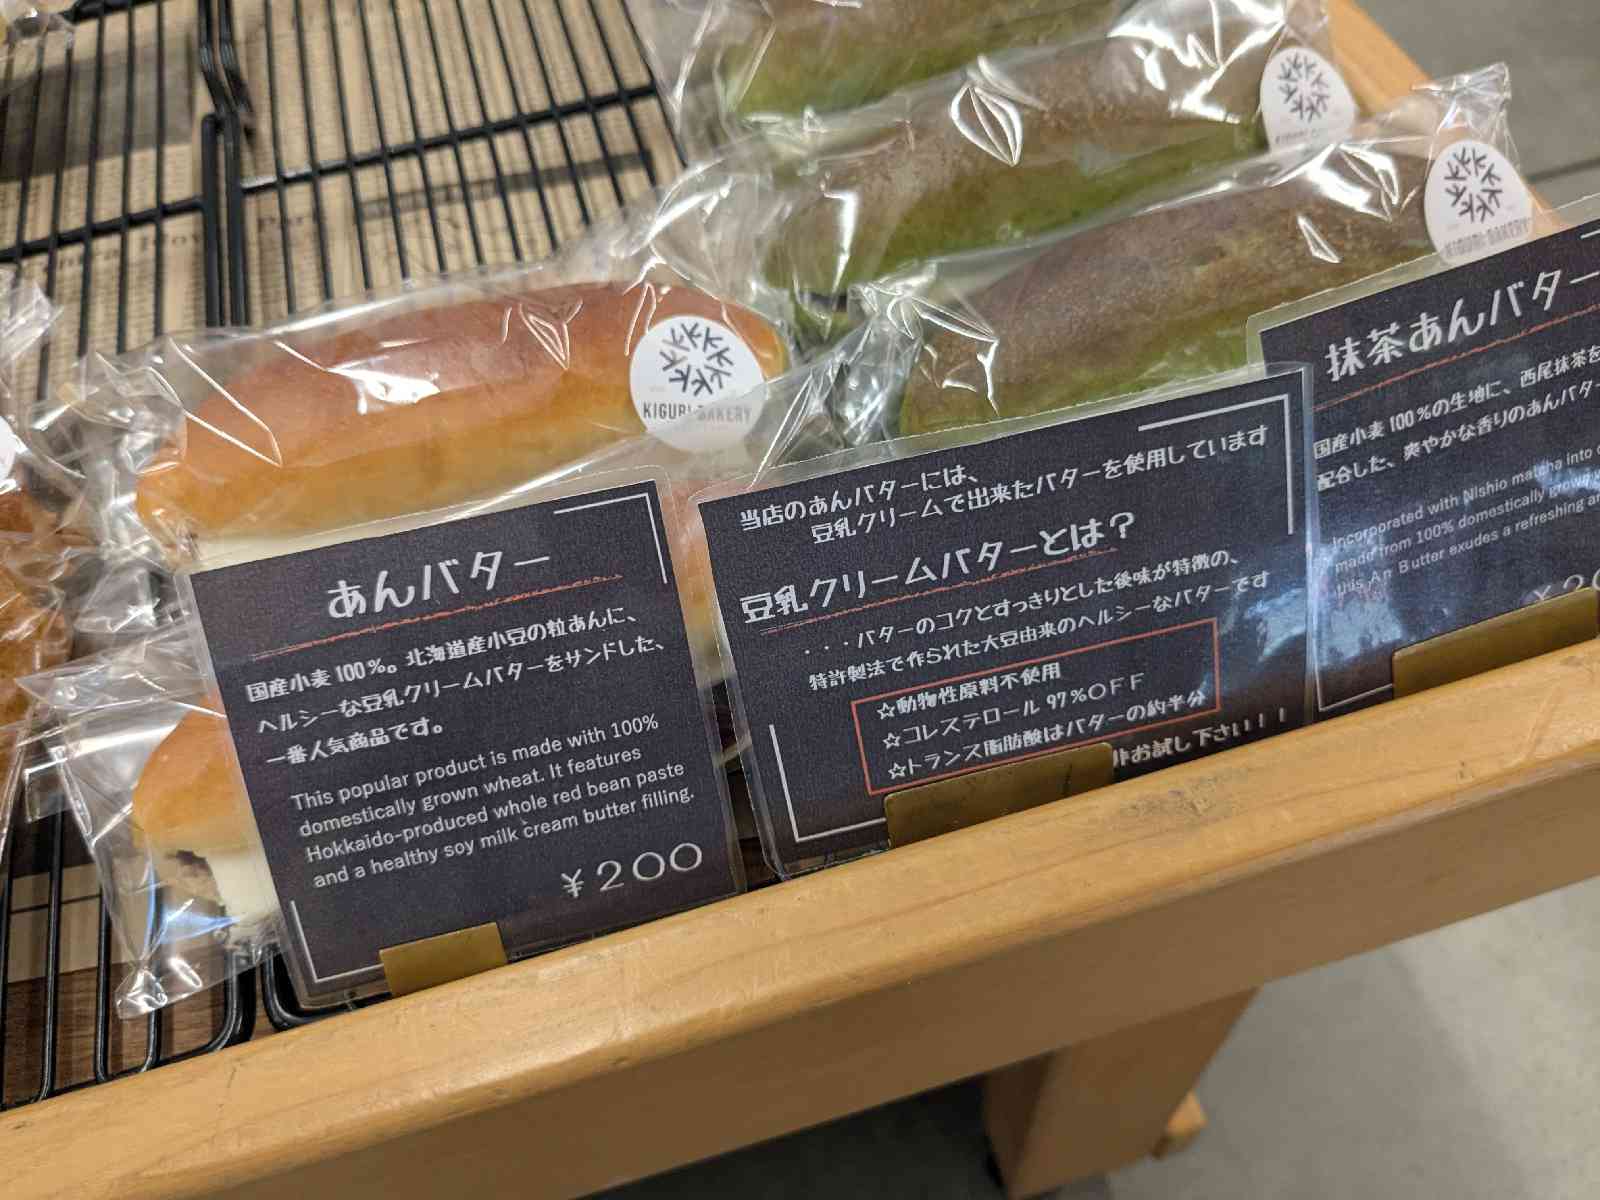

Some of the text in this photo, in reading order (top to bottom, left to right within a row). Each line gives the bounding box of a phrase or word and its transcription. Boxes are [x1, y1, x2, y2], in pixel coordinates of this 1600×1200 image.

[740, 465, 979, 532] 当店のあんバターには、
[812, 425, 1268, 545] 豆乳クリームで出来たバターを使用しています
[1416, 519, 1455, 544] 100%
[1458, 486, 1545, 529] domestically
[1427, 495, 1459, 515] with
[1566, 448, 1593, 465] into
[1449, 530, 1499, 556] exudes
[1503, 526, 1511, 537] a
[1515, 498, 1584, 533] refreshing
[326, 550, 550, 619] あんバター
[258, 634, 665, 736] ヘルシーな豆乳クリームバターをサンドした、
[266, 716, 443, 765] 一番人気商品です。
[290, 713, 659, 810] This popular product is made with 100%
[299, 748, 642, 838] domestically grown wheat. It features
[306, 763, 684, 863] Hokkaido-produced whole red bean paste
[313, 786, 695, 888] and a healthy soy milk cream butter filling.
[561, 843, 703, 899] ¥200
